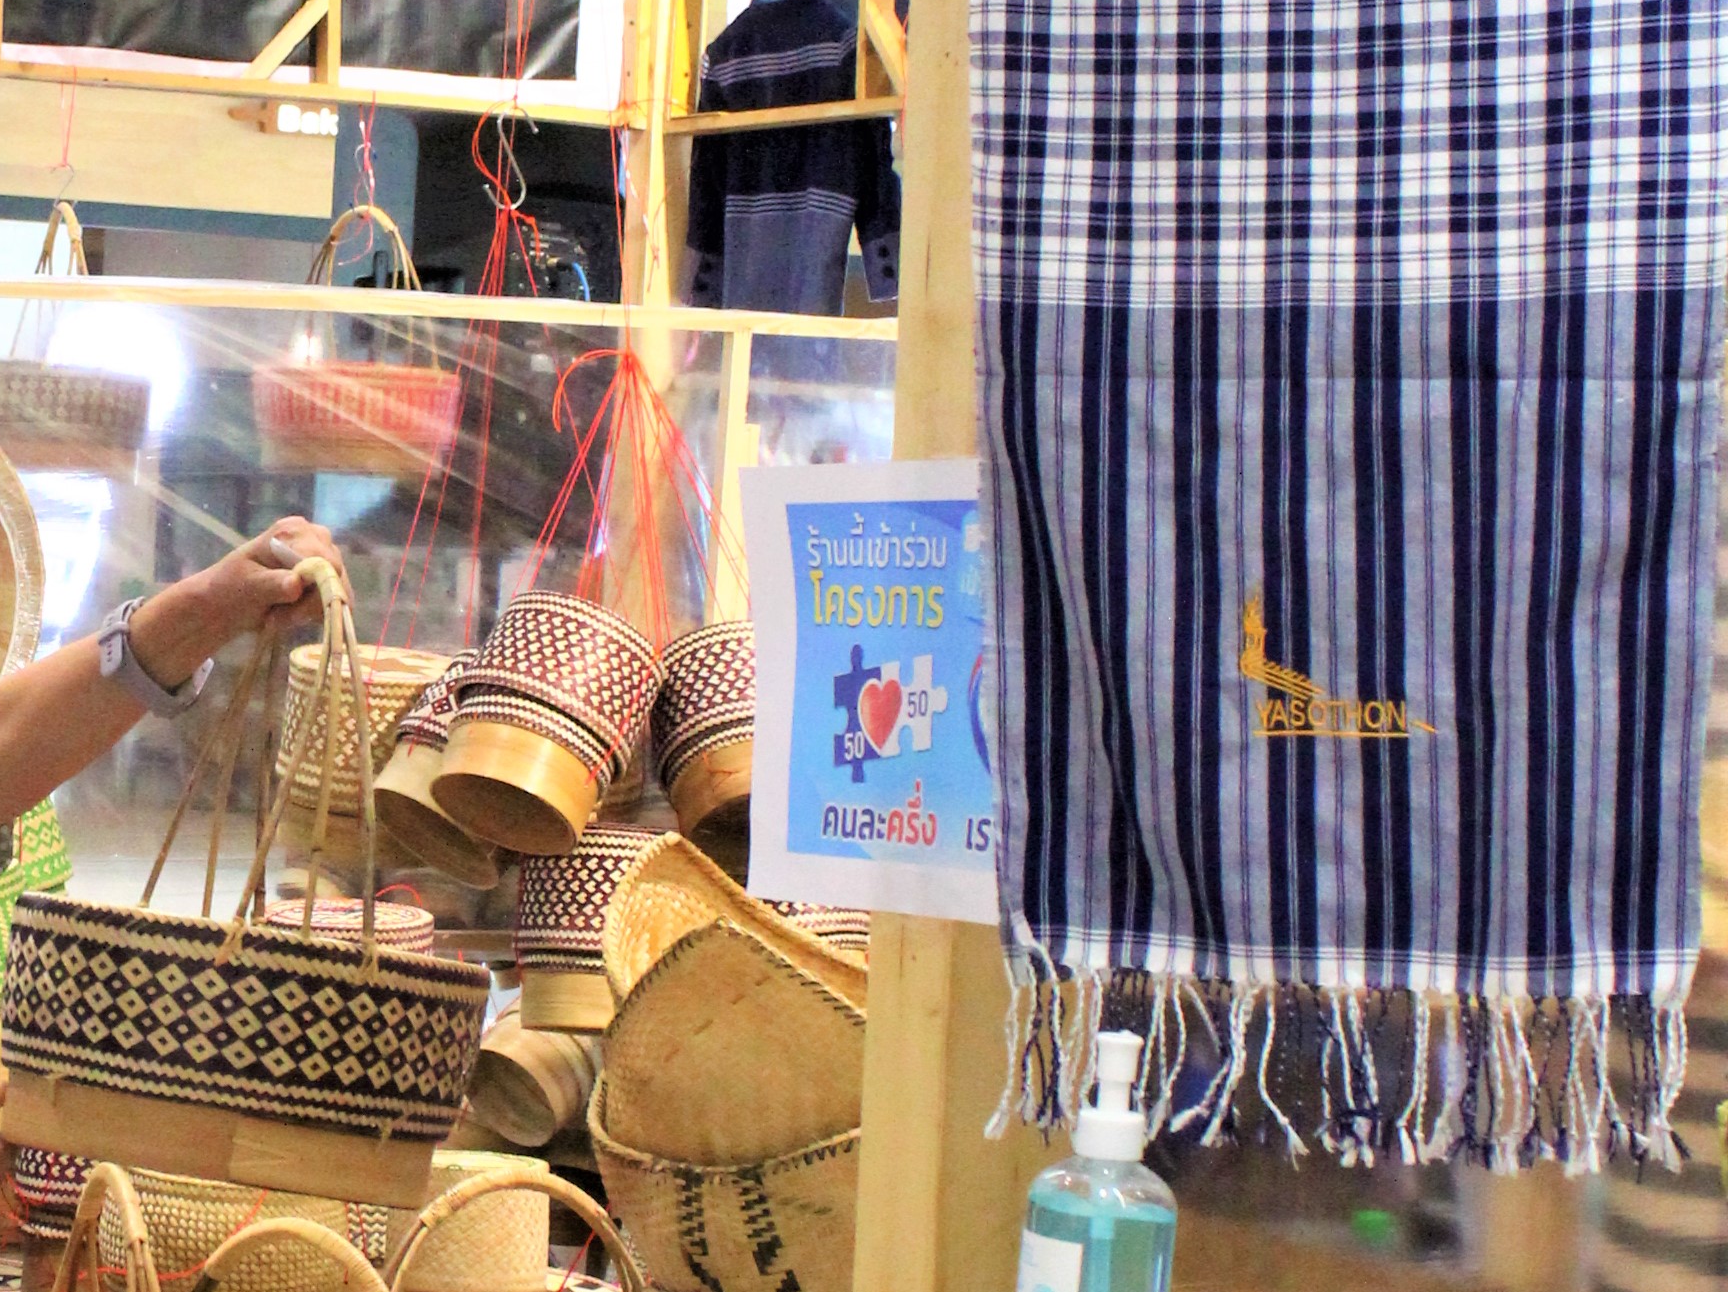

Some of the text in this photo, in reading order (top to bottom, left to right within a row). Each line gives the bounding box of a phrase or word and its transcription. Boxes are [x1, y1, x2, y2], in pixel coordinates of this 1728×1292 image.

[807, 512, 948, 569] ร้านนี้เข้าร่วม
[809, 570, 945, 628] โครงการ
[906, 690, 930, 719] 50
[1255, 699, 1408, 730] YASOTHON
[843, 731, 867, 762] 50
[822, 778, 996, 853] คนละครึ่ง เร
